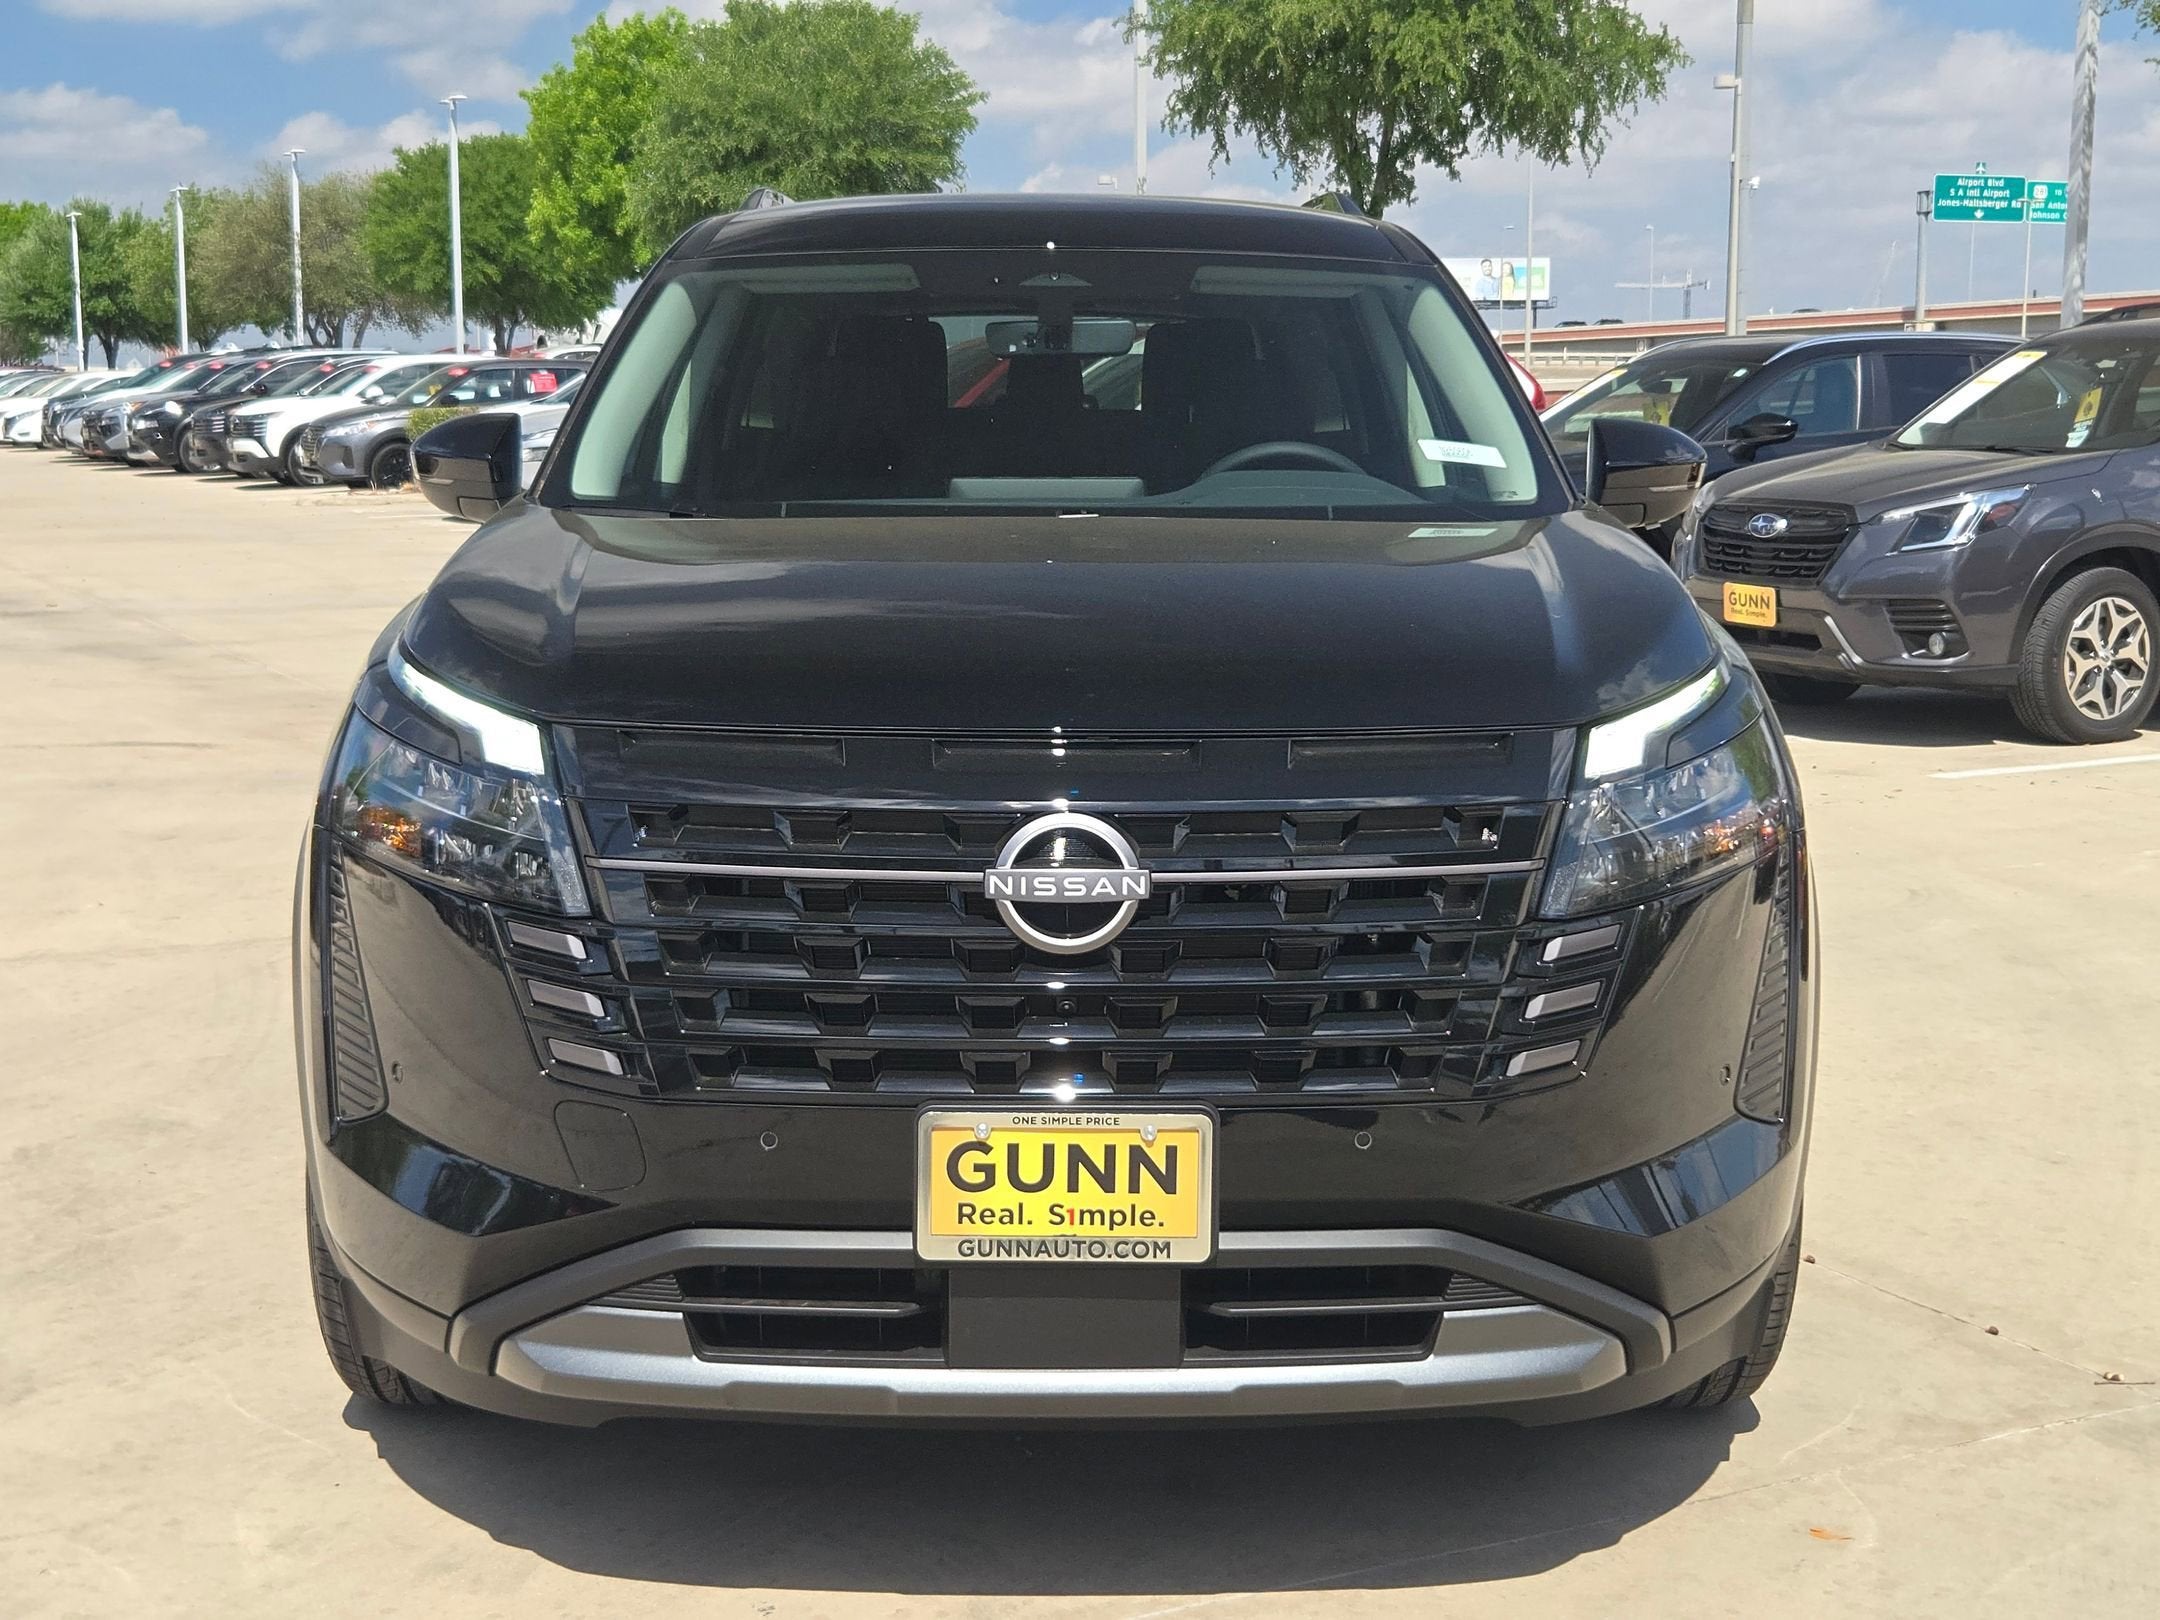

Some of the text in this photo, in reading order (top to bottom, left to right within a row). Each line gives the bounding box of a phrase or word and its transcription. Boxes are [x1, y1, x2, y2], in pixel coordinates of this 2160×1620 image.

[1957, 177, 2004, 187] Airport Blvd
[1950, 188, 1955, 196] S
[1958, 188, 1964, 196] A
[1983, 188, 2010, 199] Airport
[1729, 592, 1770, 610] GUNN
[988, 874, 1146, 897] NISSAN
[1012, 1116, 1121, 1126] ONE SIMPLE PRICE
[946, 1140, 1178, 1195] GUNN
[957, 1202, 1033, 1226] Real.
[957, 1239, 1171, 1260] GUNNAUTO.COM
